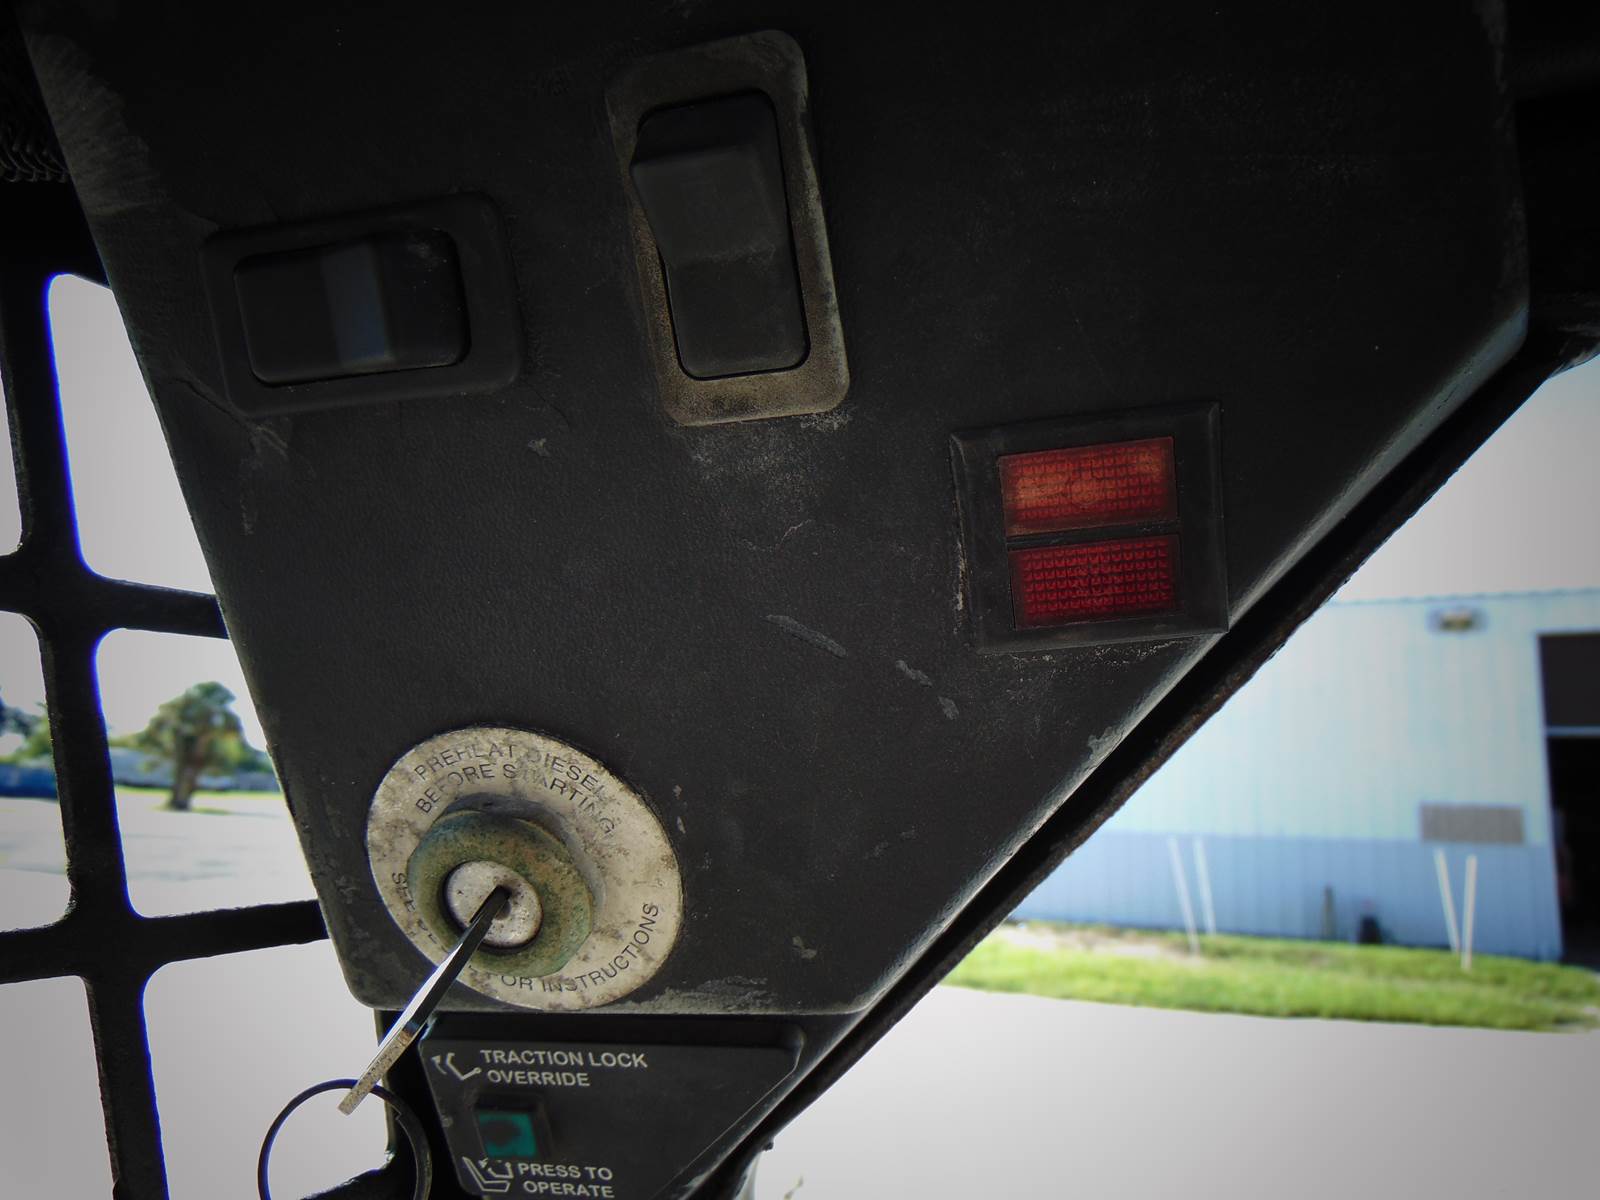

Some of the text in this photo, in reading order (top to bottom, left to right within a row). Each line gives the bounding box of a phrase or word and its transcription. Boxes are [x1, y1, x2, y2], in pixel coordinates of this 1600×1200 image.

[415, 763, 496, 814] BEFORE
[542, 902, 659, 993] INSTRUCTIONS
[480, 1049, 648, 1068] TRACTION LOCK
[487, 1069, 591, 1087] OVERRIDE
[518, 1162, 613, 1181] PRESS TO
[523, 1180, 616, 1199] OPERATE
